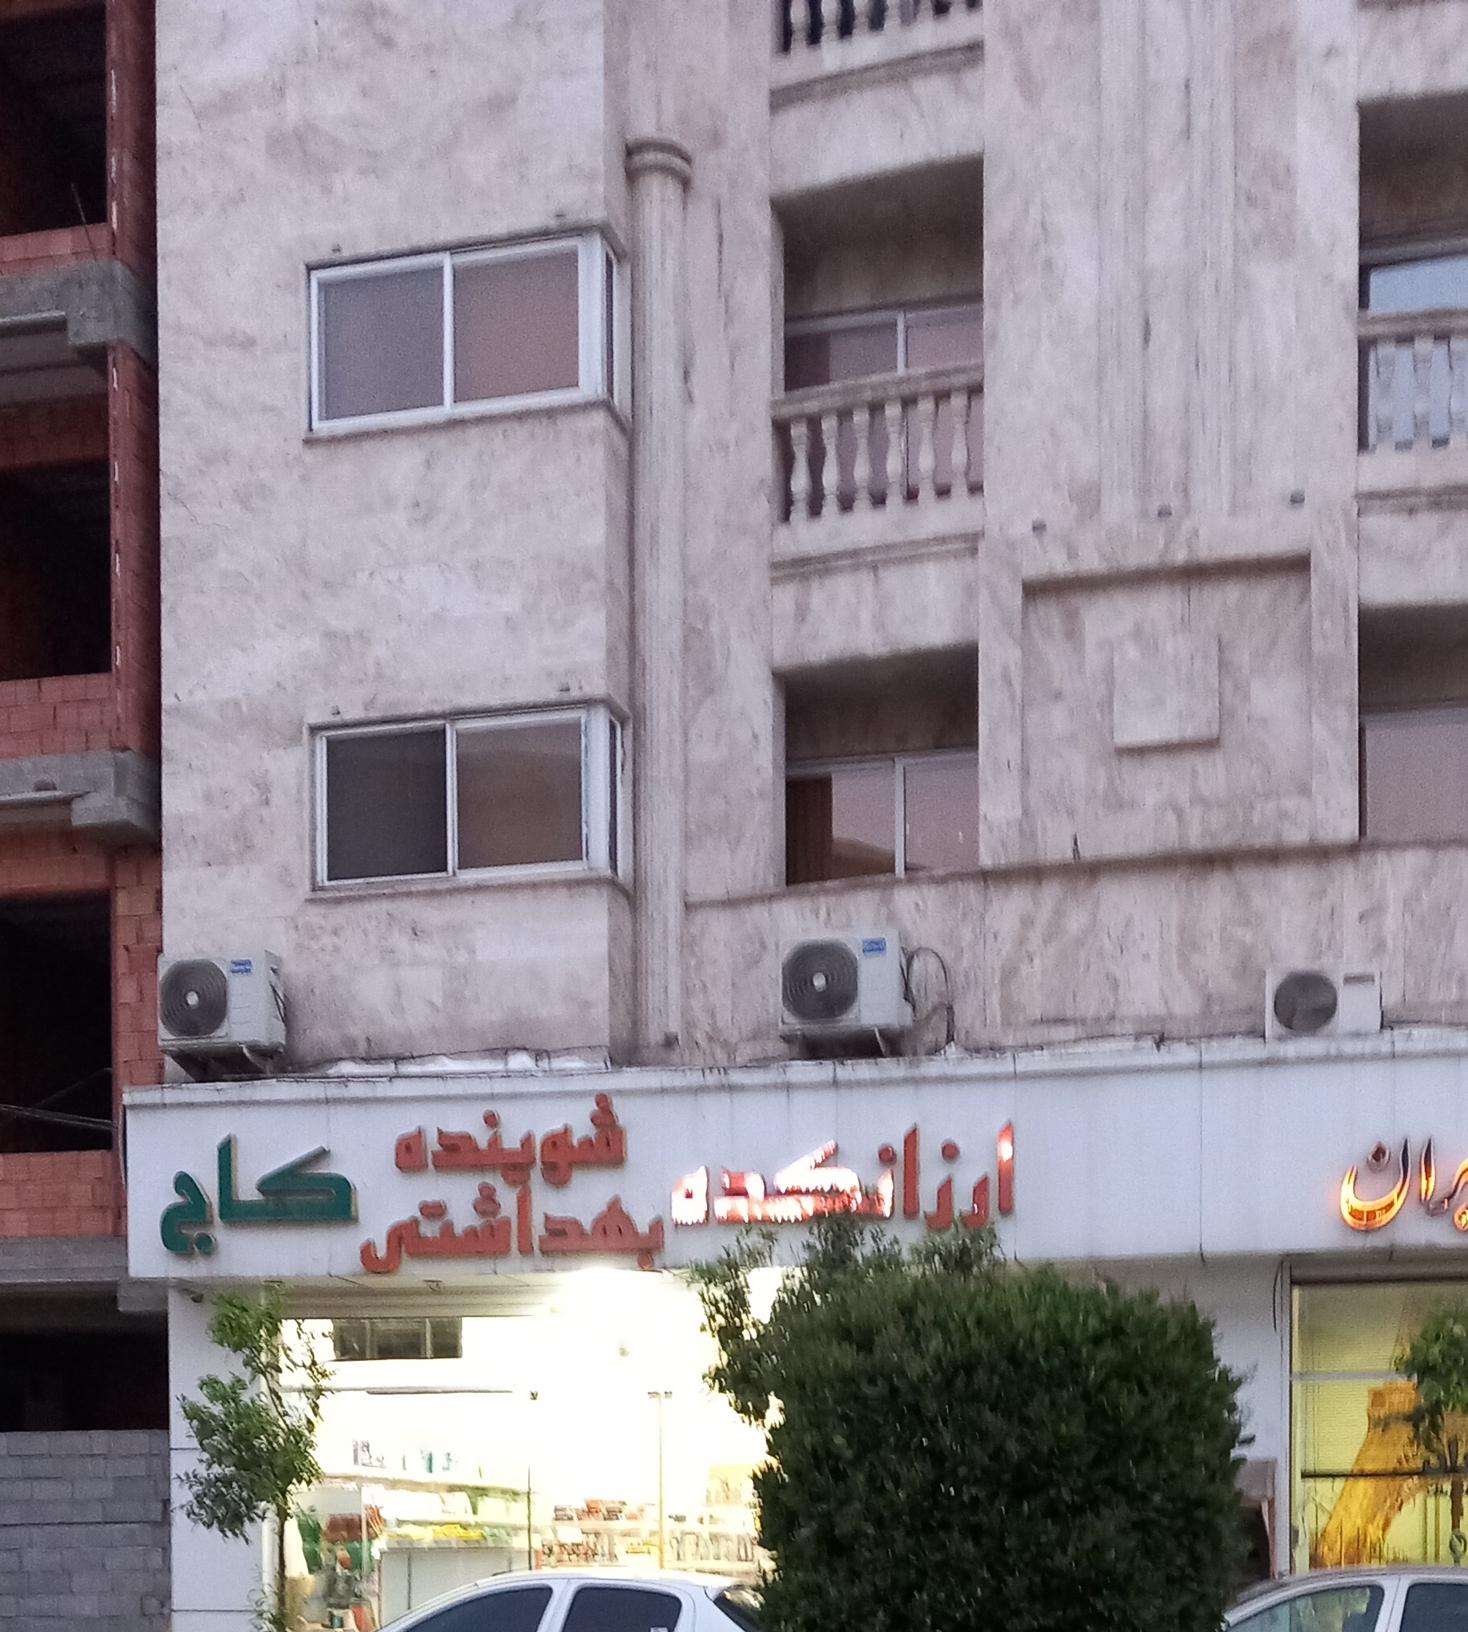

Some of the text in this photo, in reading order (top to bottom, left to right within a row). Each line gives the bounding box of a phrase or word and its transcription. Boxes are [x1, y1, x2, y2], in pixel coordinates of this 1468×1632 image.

[395, 1093, 626, 1187] شوینده
[671, 1119, 1015, 1231] ارزانکده
[160, 1133, 357, 1255] کاج
[359, 1182, 664, 1274] بهداشتی
